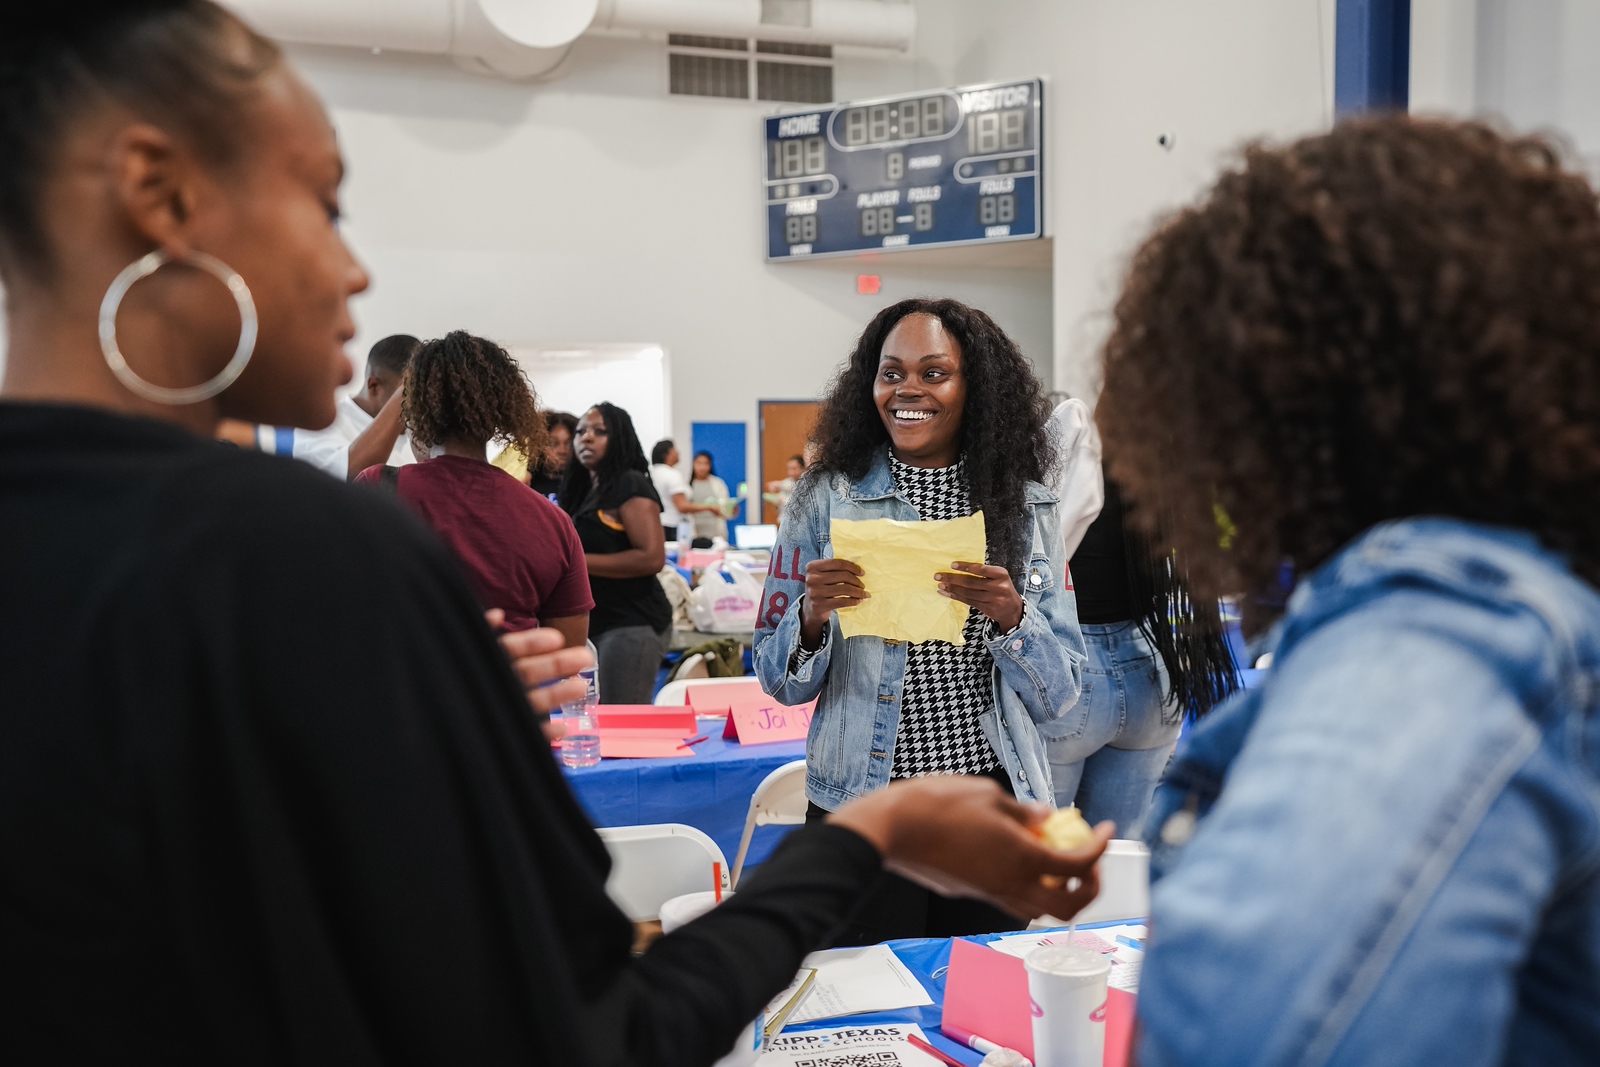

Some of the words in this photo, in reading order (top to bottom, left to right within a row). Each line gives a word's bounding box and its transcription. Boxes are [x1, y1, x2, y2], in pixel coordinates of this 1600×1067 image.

[962, 85, 1030, 113] VISITOR
[778, 113, 820, 138] HOME
[857, 190, 900, 209] PLAYER
[907, 185, 942, 203] FOULS
[768, 1043, 825, 1053] PUBLIC
[833, 1036, 905, 1046] SCHOOLS
[832, 1027, 901, 1040] TEXAS
